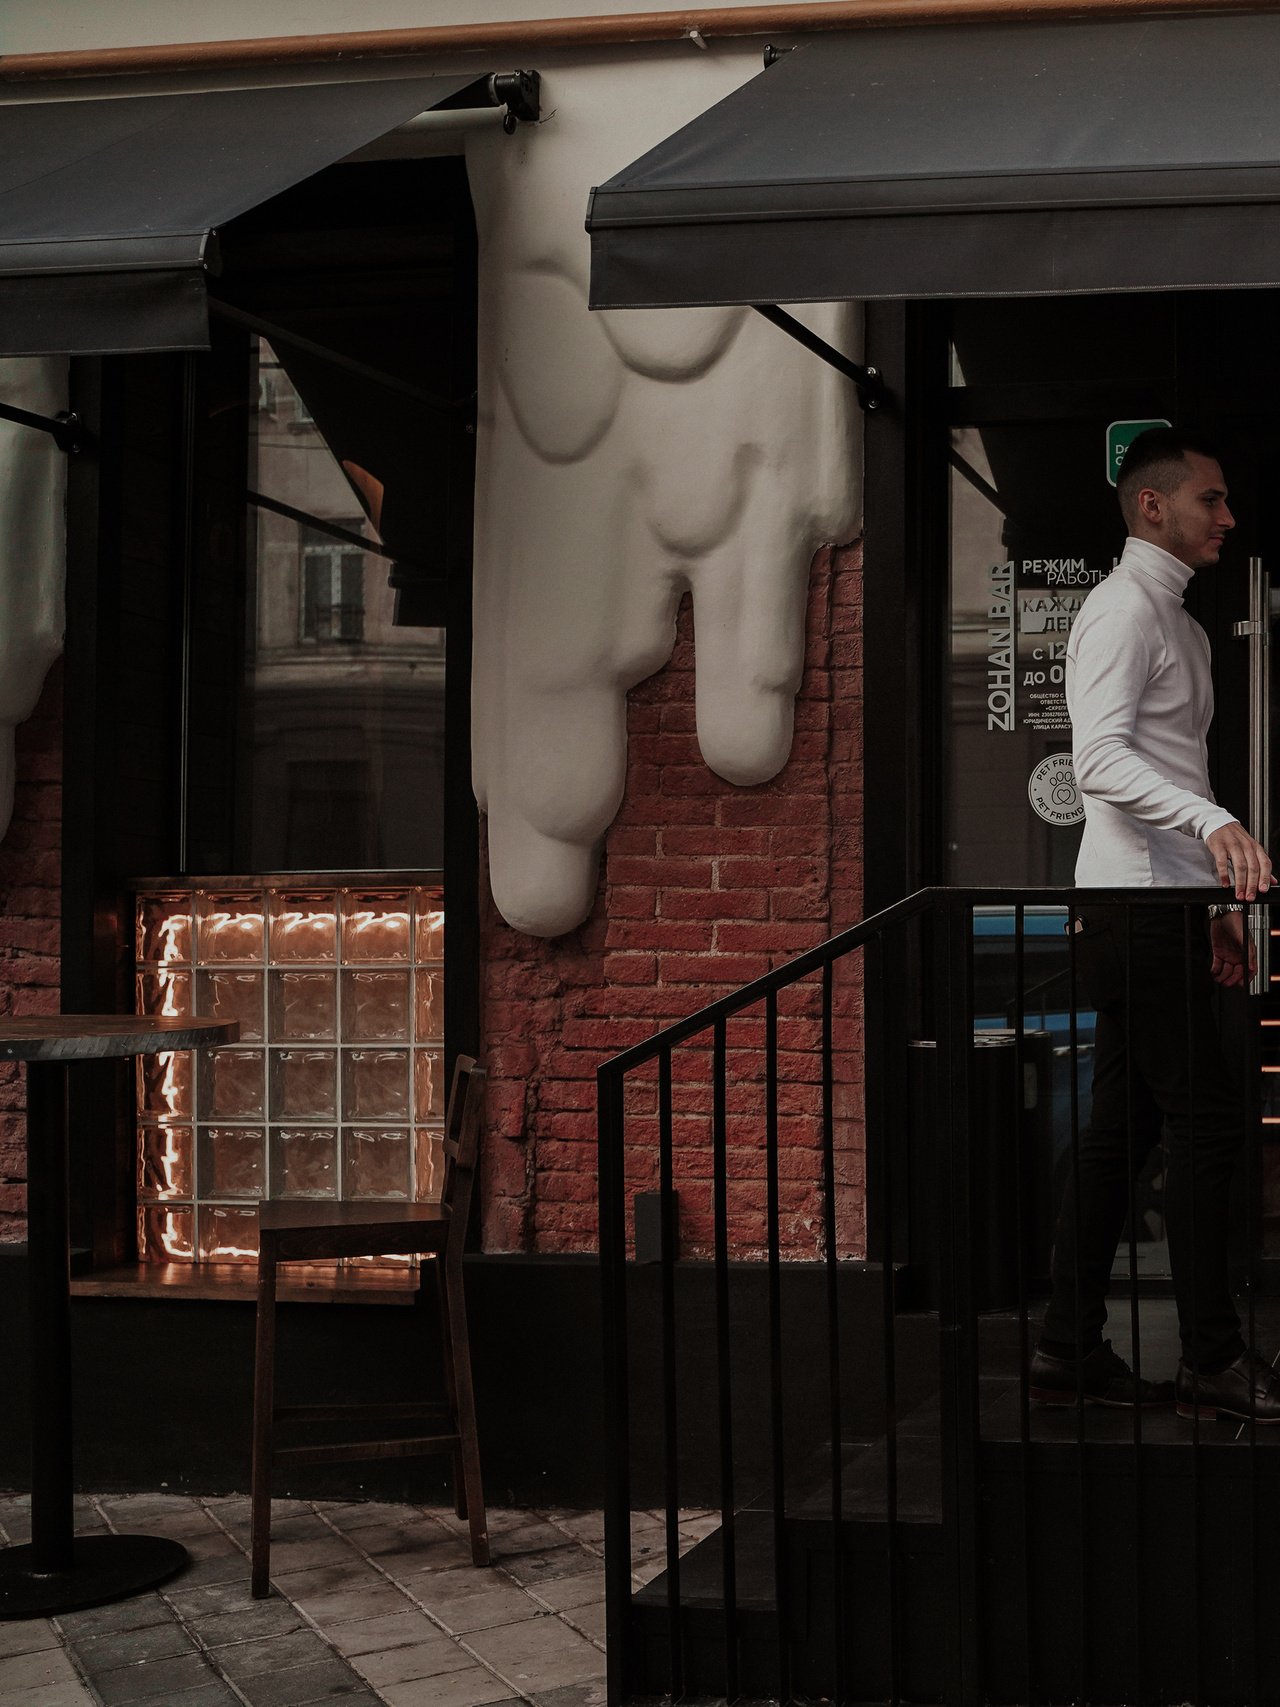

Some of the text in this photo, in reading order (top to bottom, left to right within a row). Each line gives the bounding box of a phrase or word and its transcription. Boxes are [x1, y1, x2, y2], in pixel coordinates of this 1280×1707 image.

[1022, 558, 1085, 574] РЕЖИМ
[1023, 597, 1085, 613] КАЖД
[987, 560, 1011, 731] ZOHAN BAR
[1036, 763, 1051, 781] PET
[1036, 796, 1084, 820] PET FRIEND
